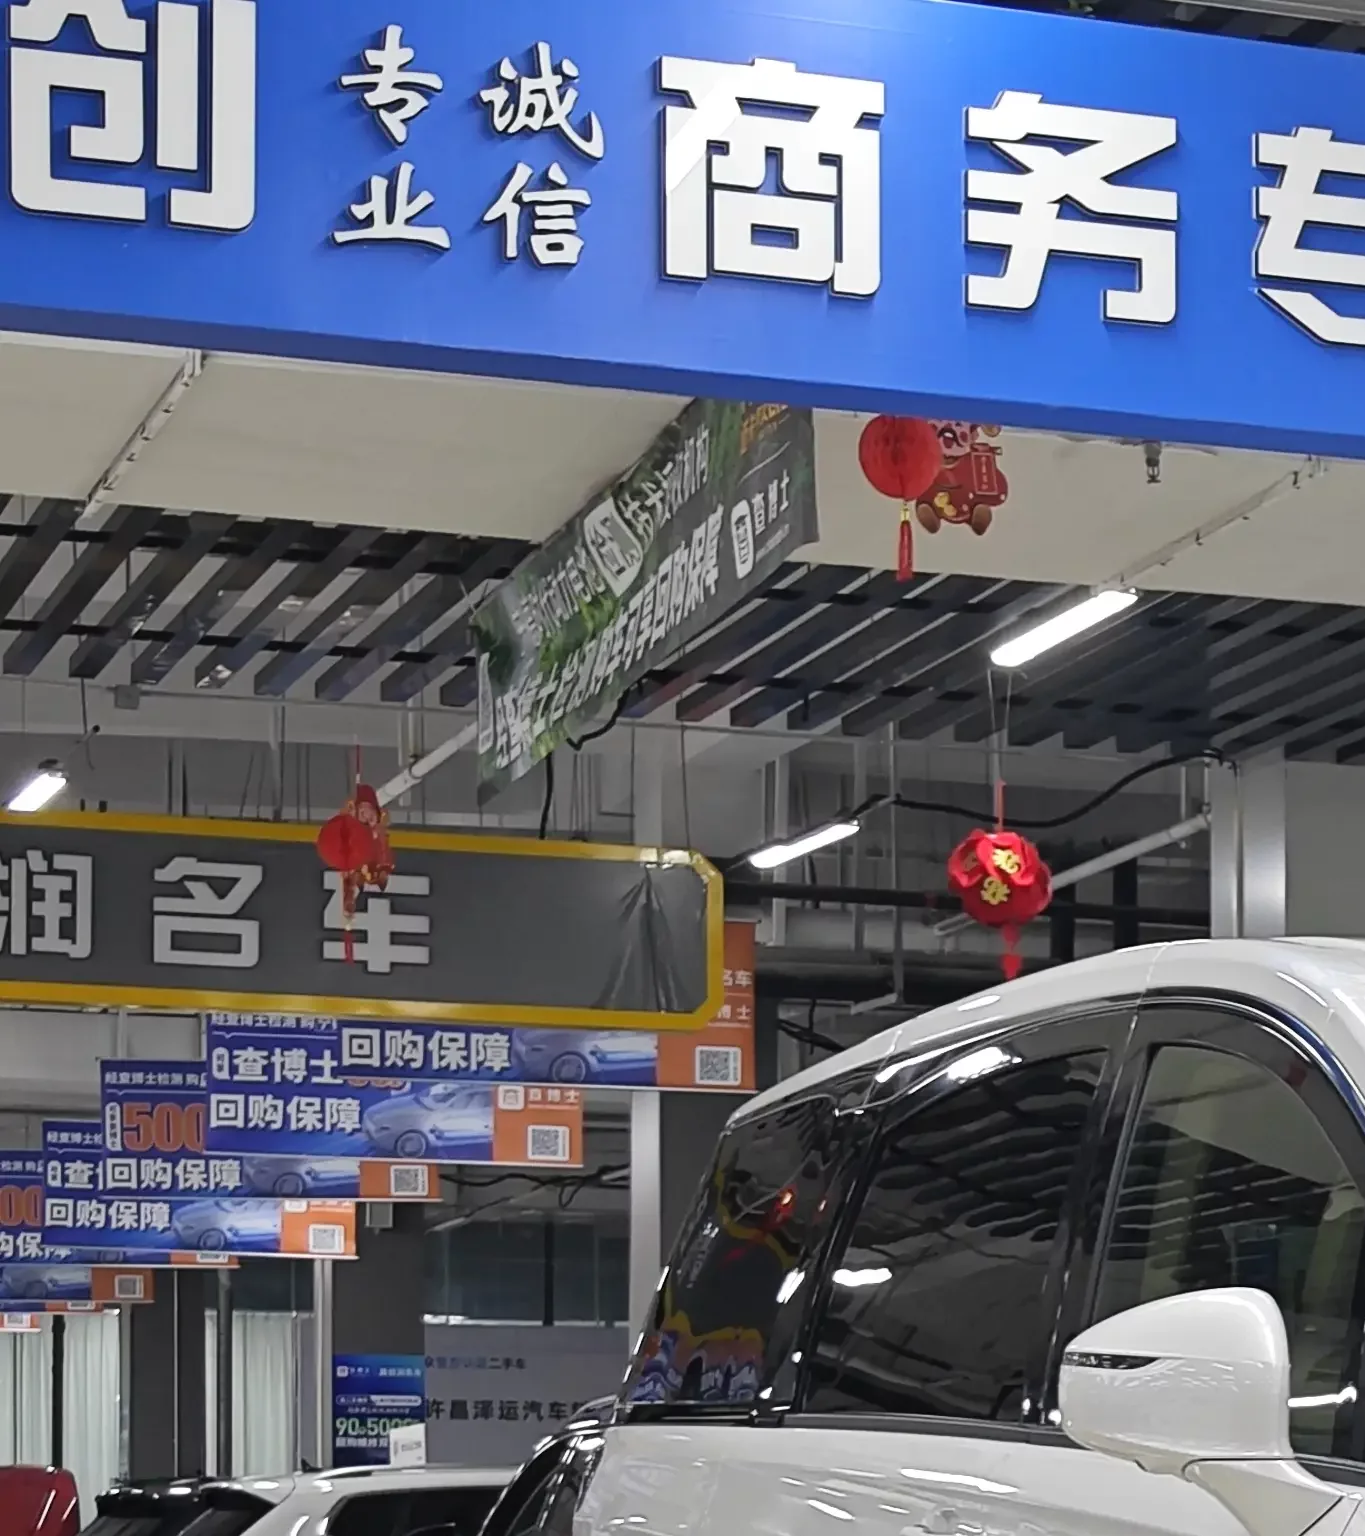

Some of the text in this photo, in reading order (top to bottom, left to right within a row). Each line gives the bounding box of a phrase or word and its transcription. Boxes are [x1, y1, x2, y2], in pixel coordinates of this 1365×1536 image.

[7, 0, 257, 232] 创
[232, 1046, 344, 1084] 查博士
[341, 1027, 512, 1073] 回购保障
[210, 1093, 362, 1134] 回购保障
[106, 1157, 242, 1191] 回购保障
[45, 1197, 171, 1231] 回购保障
